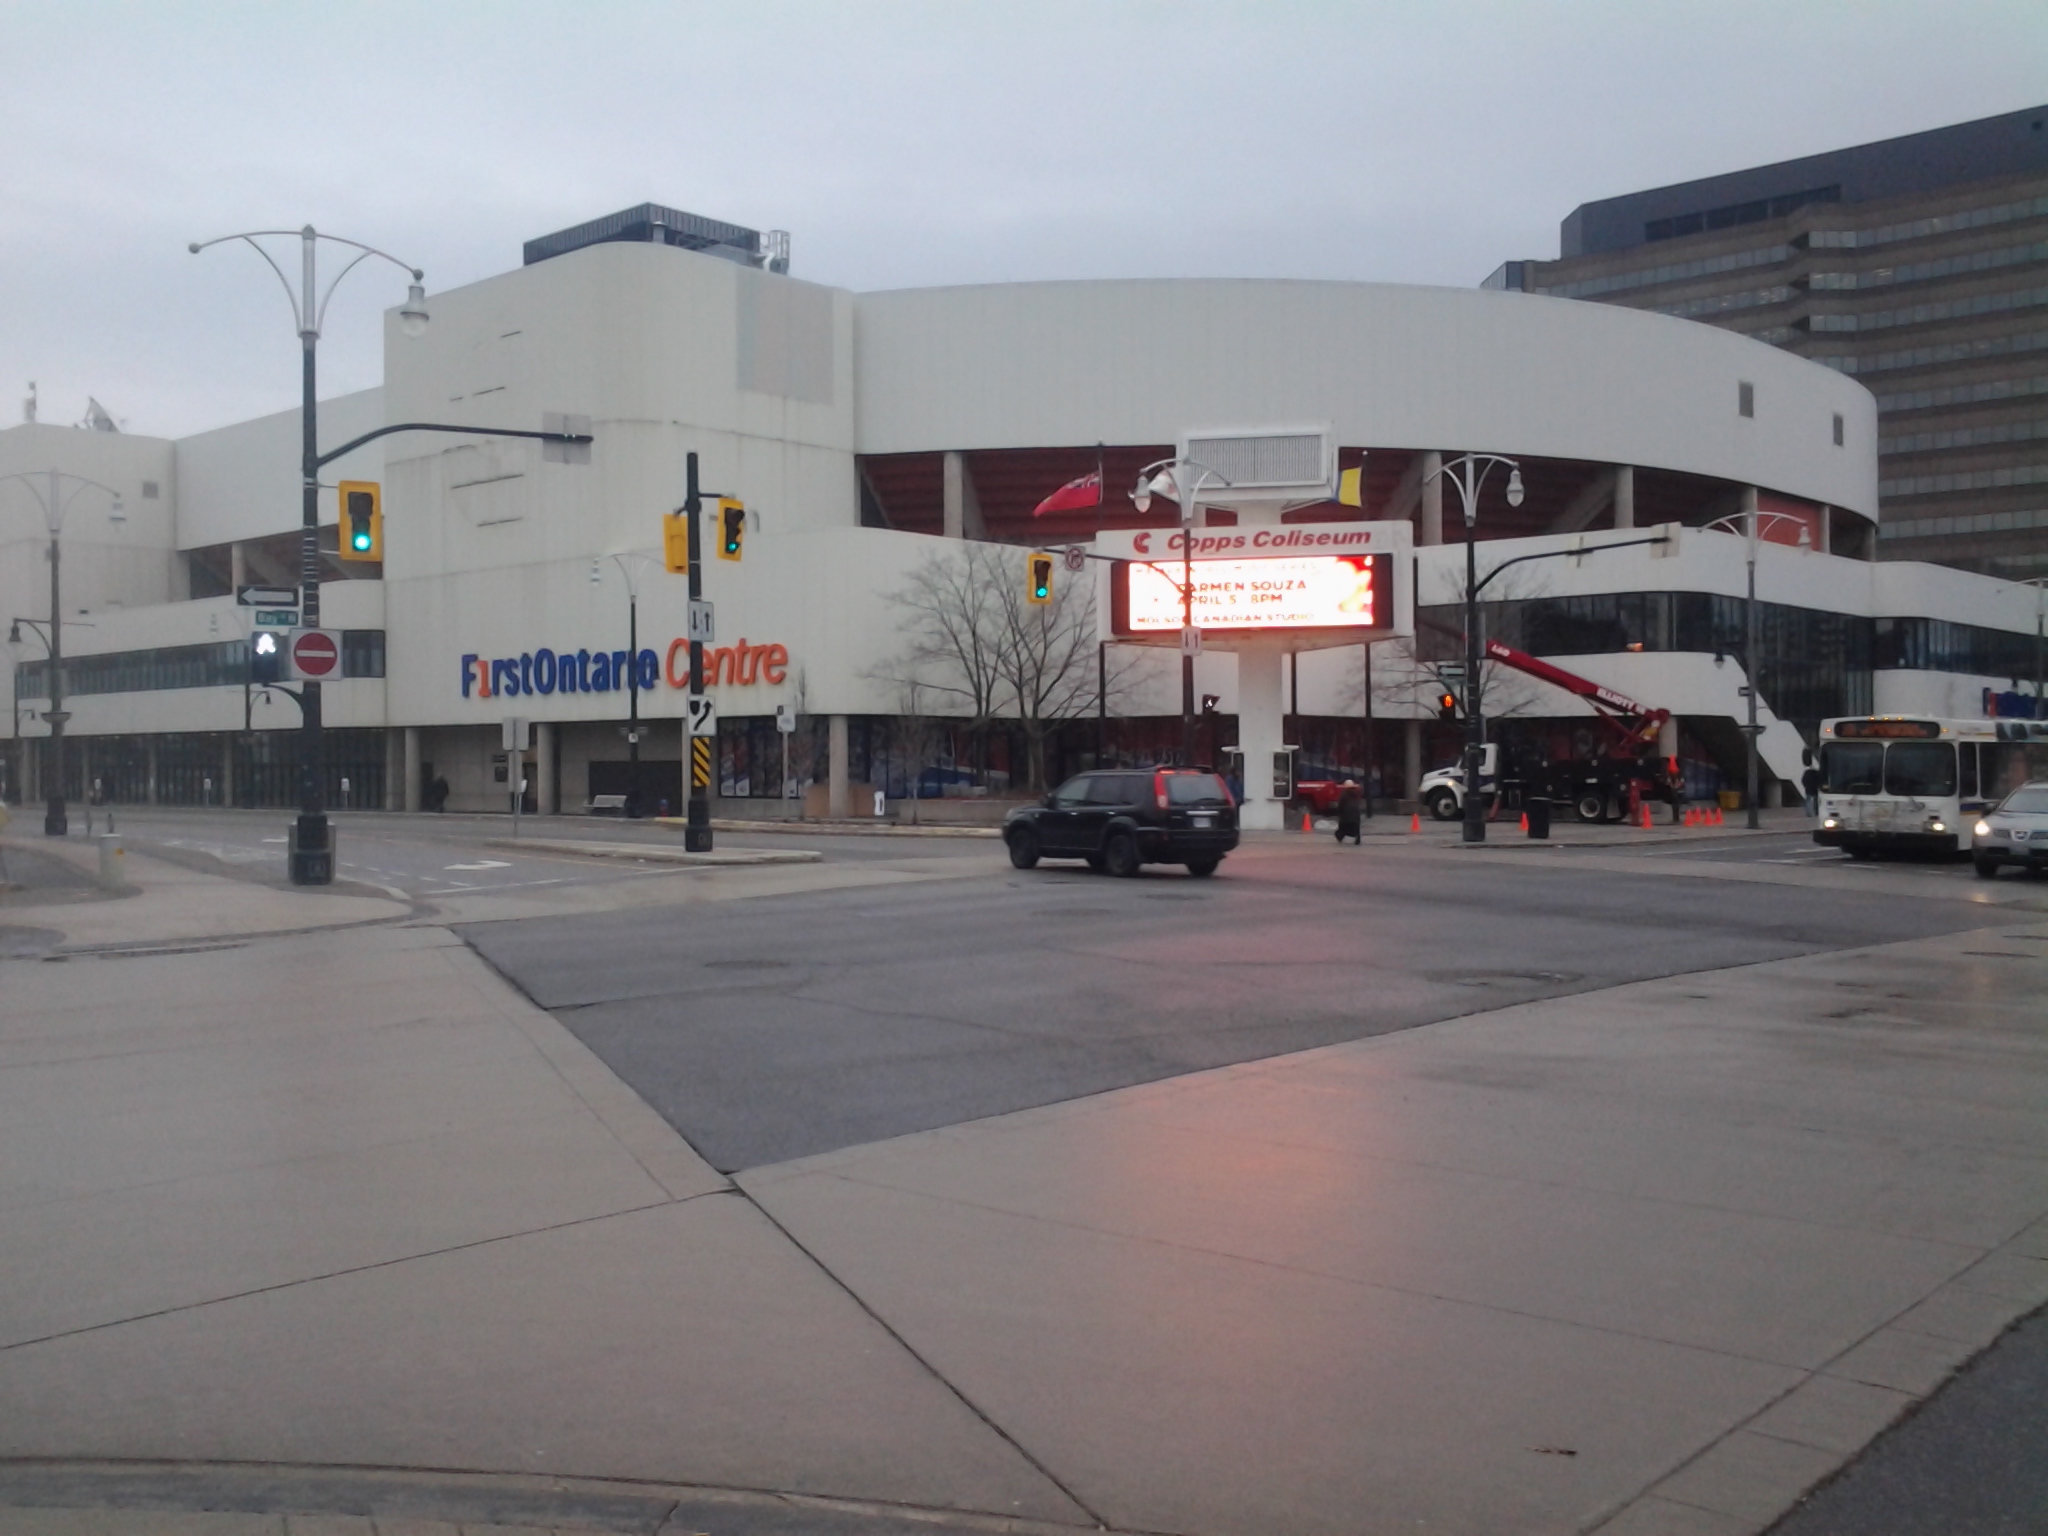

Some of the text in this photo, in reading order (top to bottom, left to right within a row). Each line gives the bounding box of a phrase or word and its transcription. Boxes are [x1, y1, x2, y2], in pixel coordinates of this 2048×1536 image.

[1167, 533, 1246, 553] Copps
[1252, 530, 1372, 549] Coliseum
[1251, 580, 1307, 591] SOUZA
[1177, 593, 1284, 605] APRIL 5 8PM
[1193, 613, 1262, 623] CANADIAN
[1266, 612, 1314, 621] STUDIO
[666, 637, 789, 689] Centre
